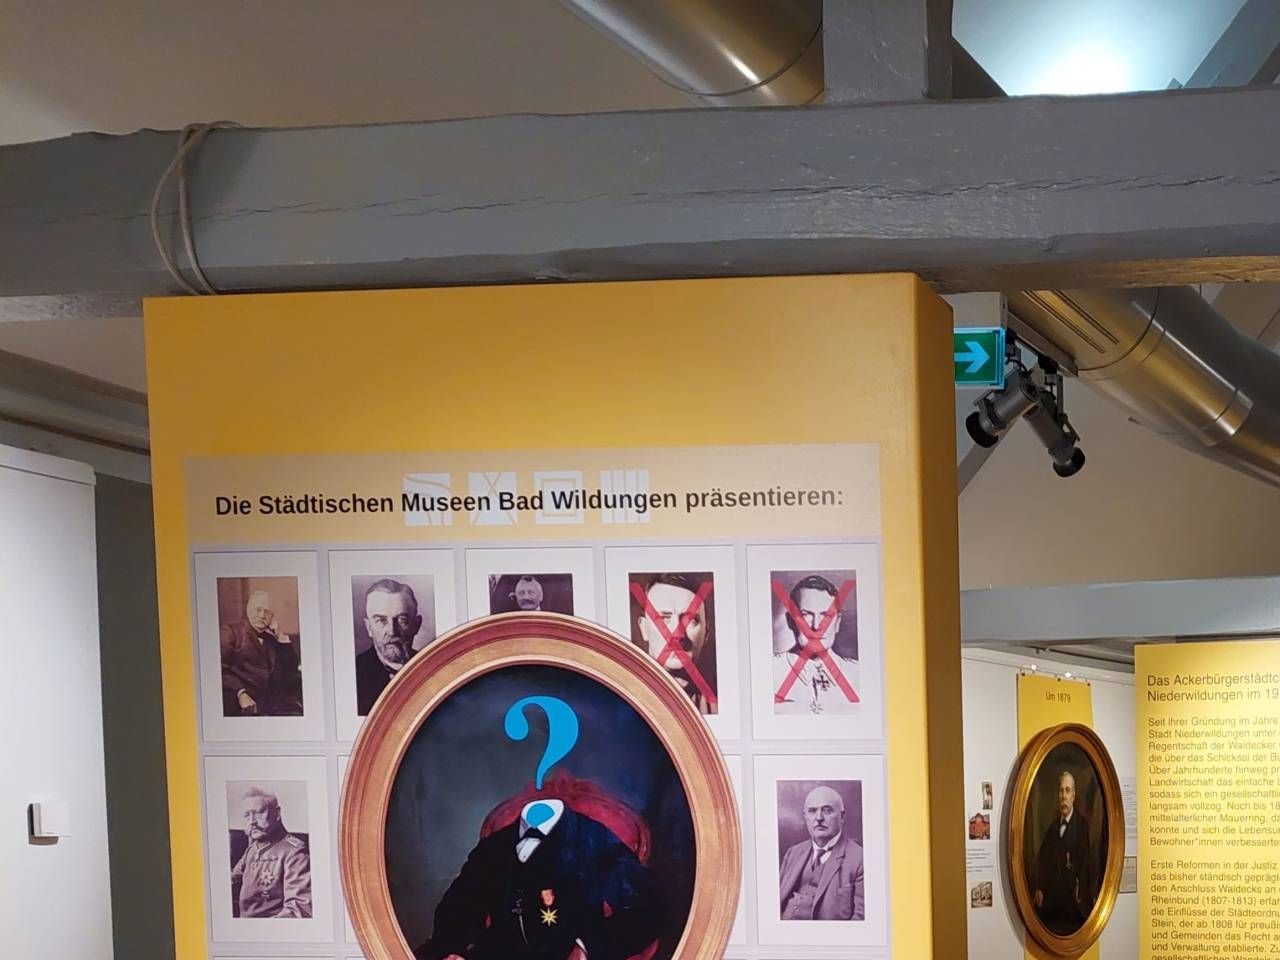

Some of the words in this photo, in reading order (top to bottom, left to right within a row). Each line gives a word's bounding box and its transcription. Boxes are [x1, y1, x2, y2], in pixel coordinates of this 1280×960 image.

[215, 495, 251, 515] Die
[259, 494, 394, 514] Städtischen
[401, 493, 491, 512] Museen
[498, 490, 544, 510] Bad
[550, 489, 677, 513] Wildungen
[685, 488, 843, 511] präsentieren:
[1146, 672, 1170, 686] Das
[1146, 688, 1244, 703] Niederwildungen
[1246, 688, 1261, 699] im
